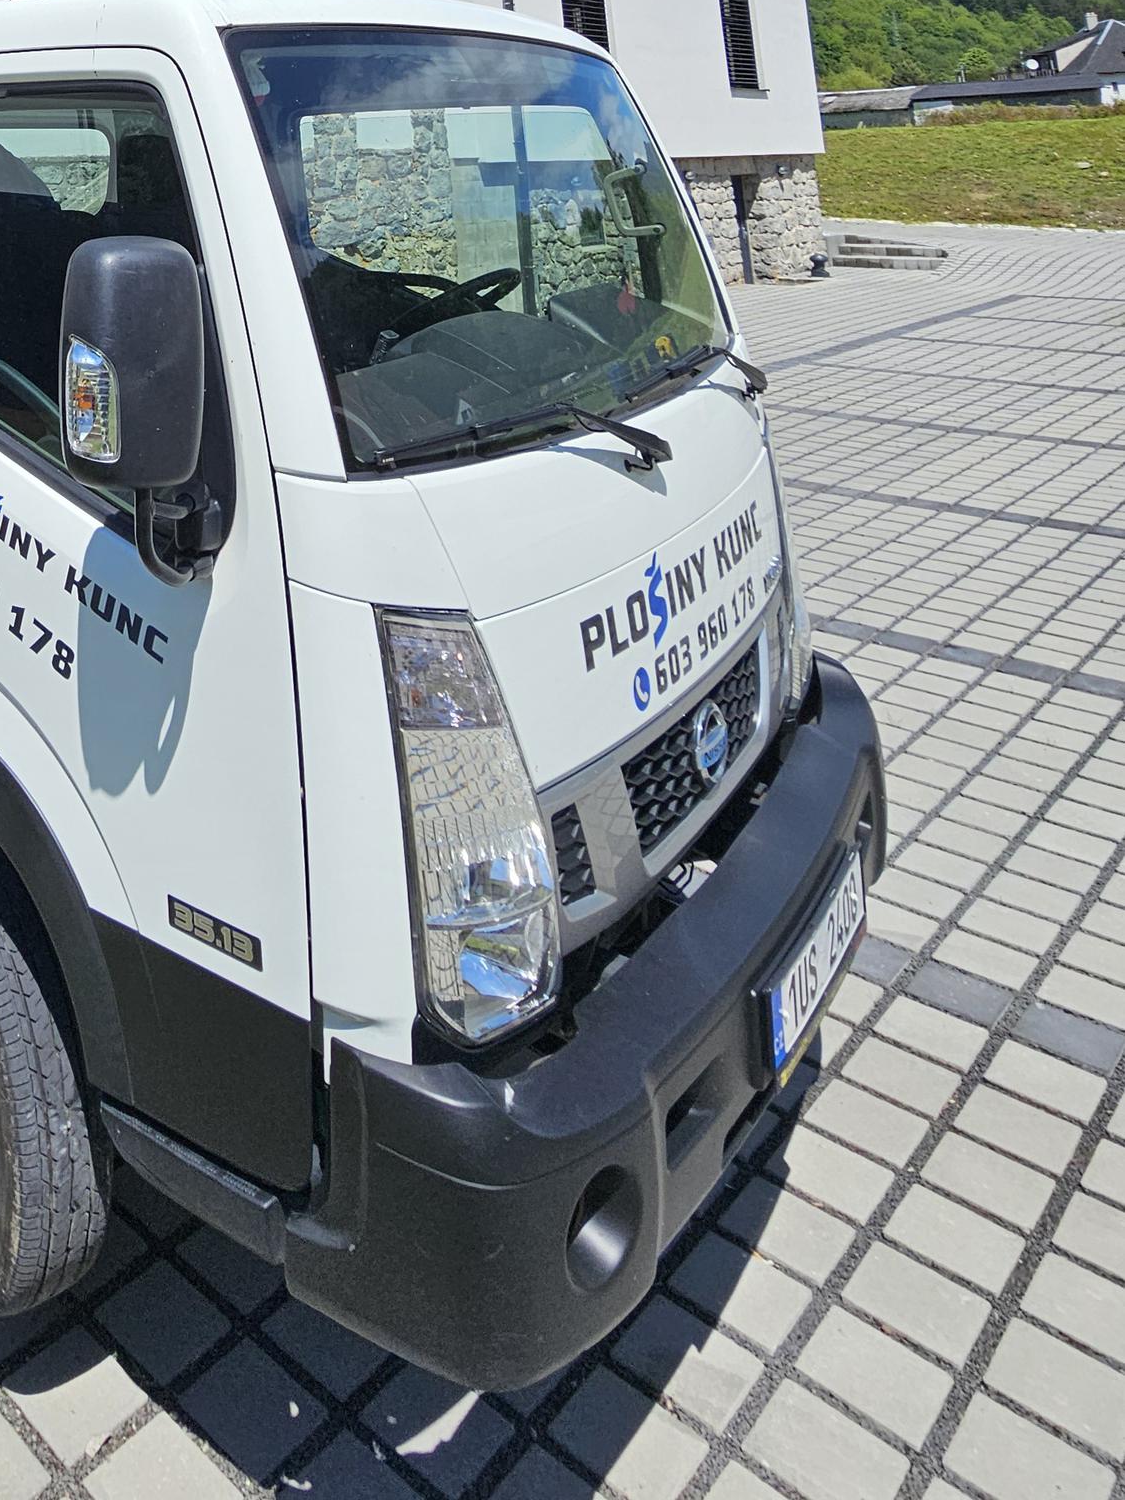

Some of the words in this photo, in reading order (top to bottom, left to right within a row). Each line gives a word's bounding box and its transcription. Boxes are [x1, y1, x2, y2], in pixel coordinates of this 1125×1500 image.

[65, 565, 169, 664] KUNC
[580, 546, 707, 673] PLOŠINY
[713, 500, 762, 580] KUNC
[8, 605, 75, 680] 178
[654, 635, 693, 695] 603
[697, 603, 728, 660] 960
[732, 576, 755, 628] 178
[173, 902, 254, 962] 35.13
[788, 942, 818, 1028] 1US
